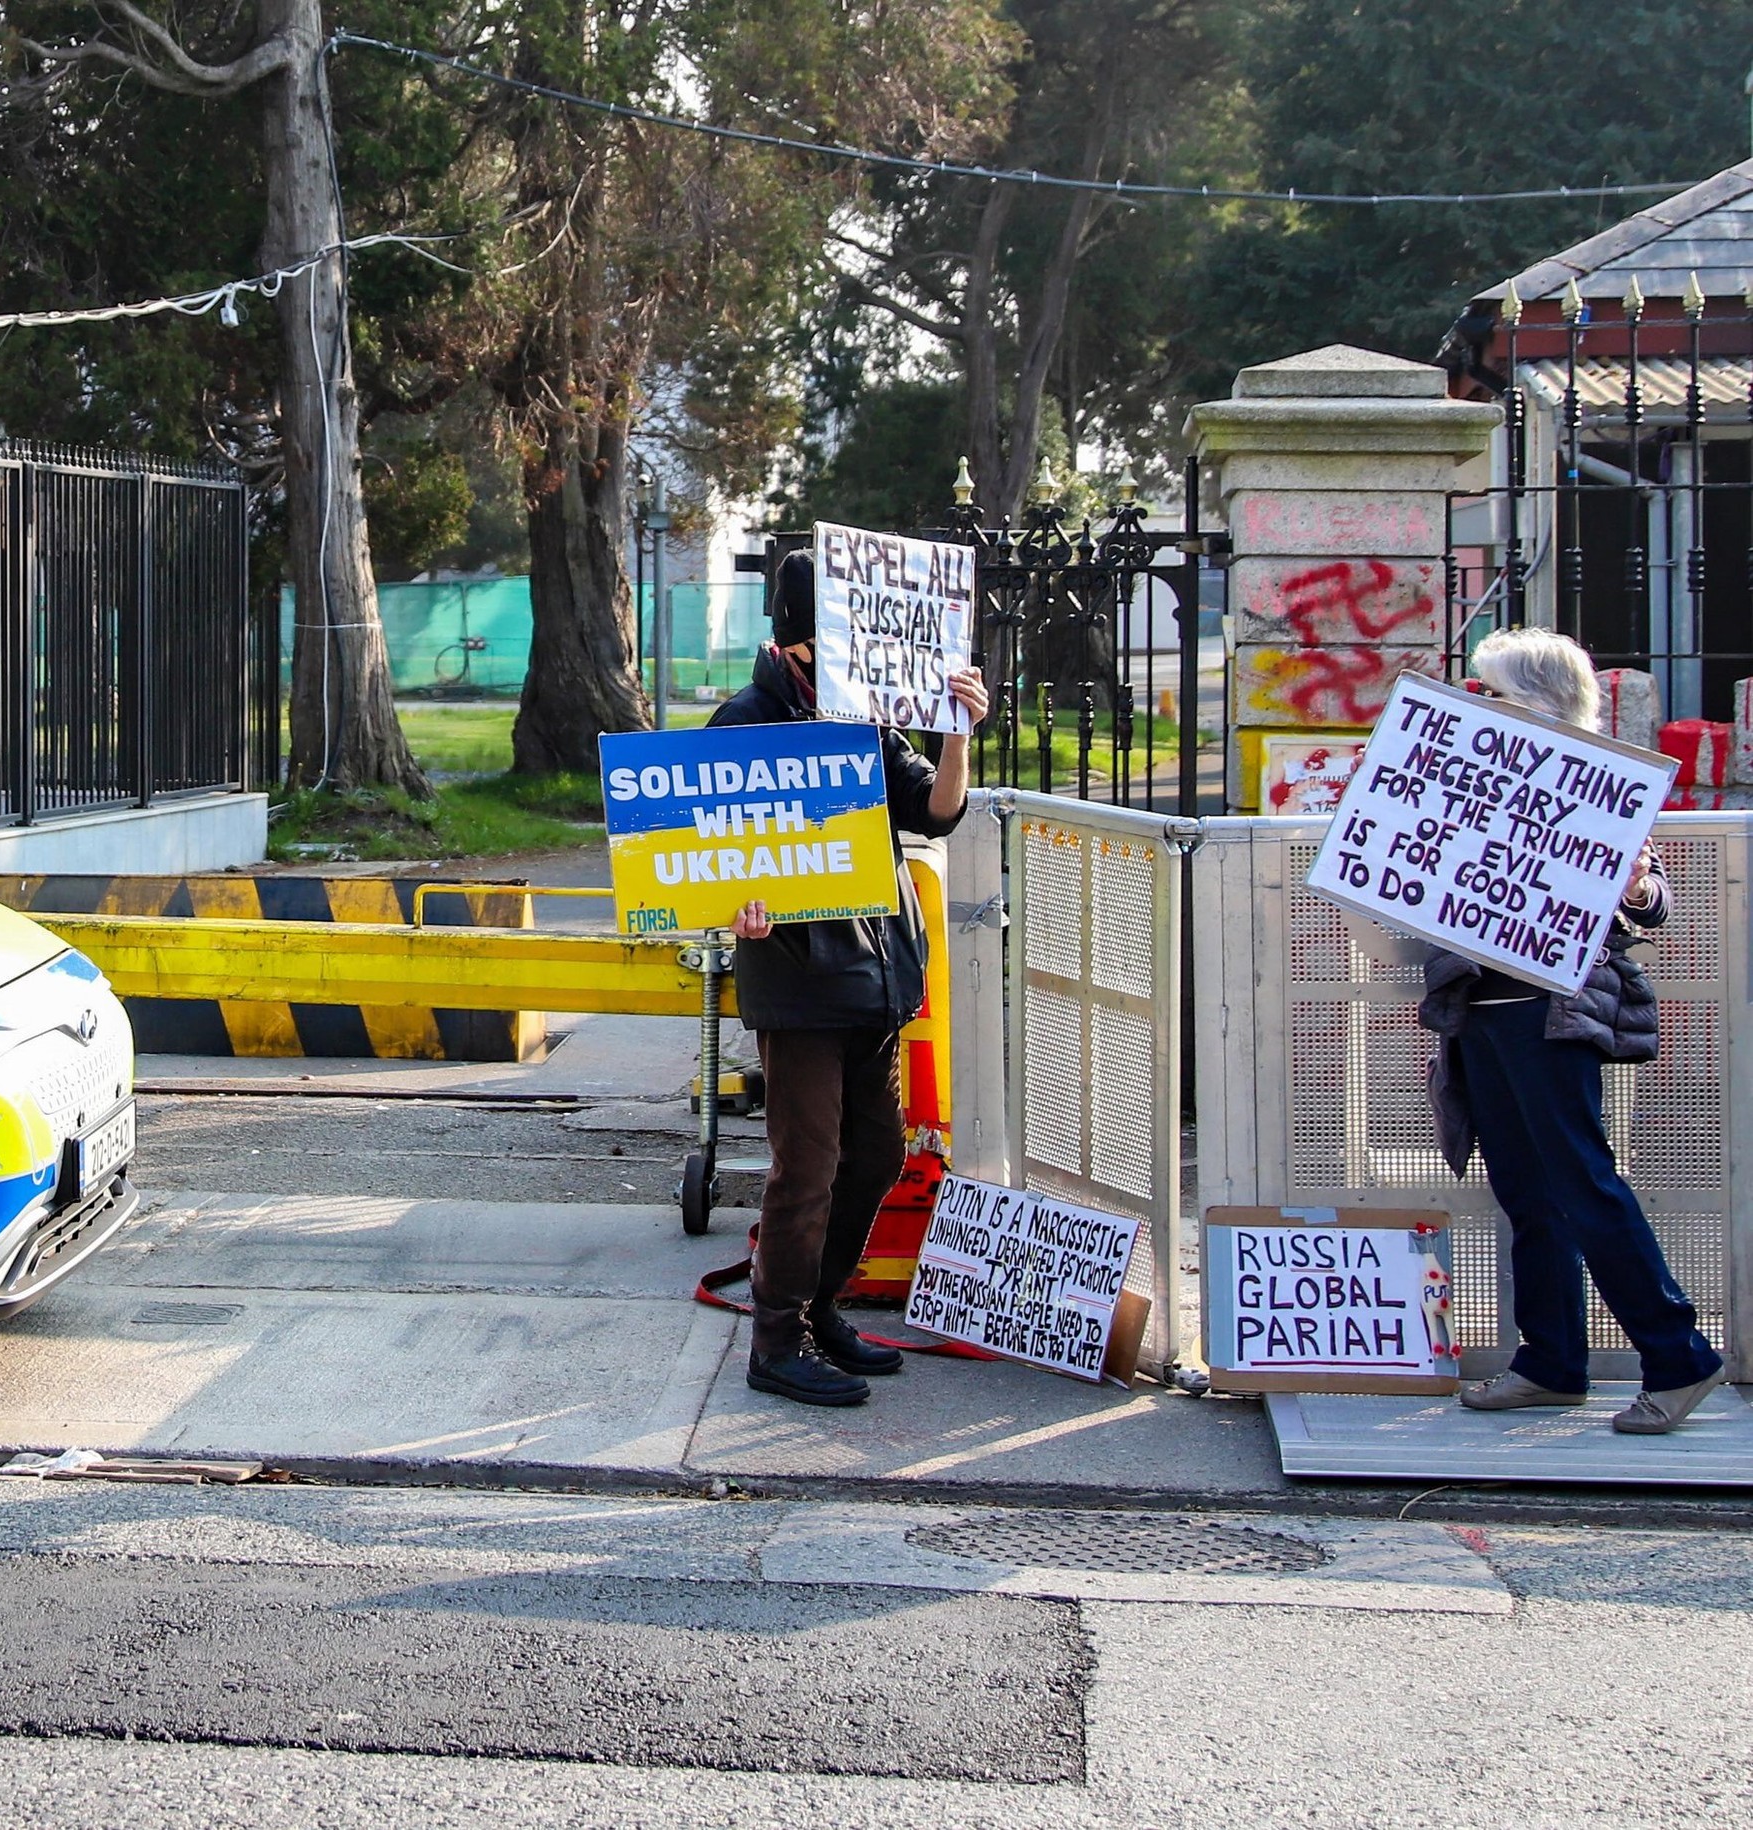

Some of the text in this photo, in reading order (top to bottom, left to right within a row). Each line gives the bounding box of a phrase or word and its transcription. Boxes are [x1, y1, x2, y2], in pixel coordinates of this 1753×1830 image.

[824, 528, 970, 601] EXPEL ALL
[848, 588, 944, 644] RUSSIAN
[848, 634, 945, 695] AGENTS
[608, 752, 878, 801] SOLIDARITY
[1400, 697, 1648, 819] THE ONLY THING
[1404, 743, 1580, 828] NECESSARY
[692, 799, 806, 838] WITH
[1368, 765, 1625, 881] FOR THE TRIUMPH
[654, 840, 853, 885] UKRAINE
[1337, 851, 1370, 888] TO
[1378, 866, 1426, 906] DO
[1417, 817, 1553, 892] OF EVIL
[1387, 831, 1443, 876] FOR
[1454, 861, 1527, 913] GOOD
[1536, 895, 1602, 944] MEN
[626, 901, 679, 933] FÓRSA
[937, 1178, 988, 1222] PUTIN
[1007, 1201, 1024, 1234] A
[1237, 1230, 1381, 1271] RUSSIA
[938, 1268, 960, 1298] THE
[959, 1275, 1007, 1313] RUSSIAN
[1055, 1307, 1083, 1338] NEED
[1085, 1317, 1102, 1343] TO
[1238, 1274, 1406, 1311] GLOBAL
[910, 1293, 944, 1328] STOP
[983, 1312, 1030, 1354] BEFORE
